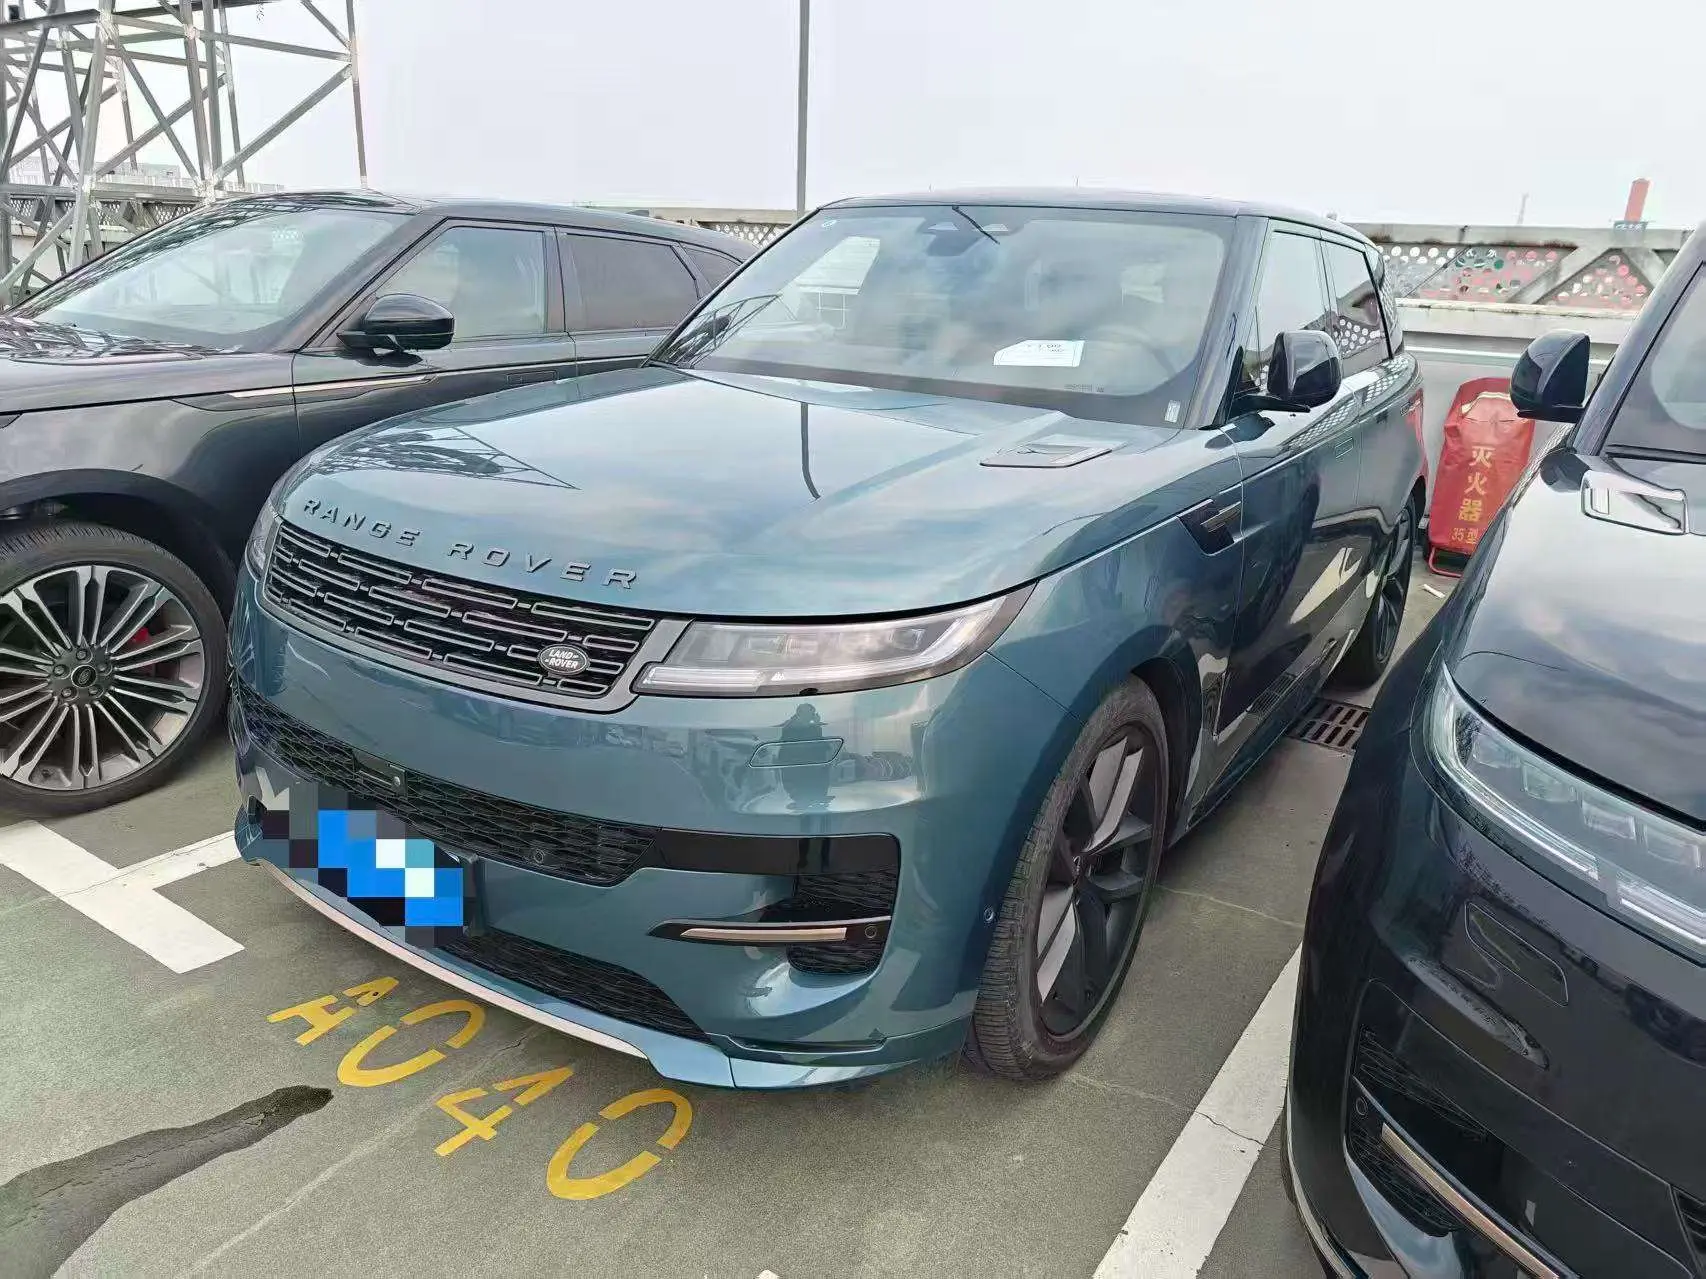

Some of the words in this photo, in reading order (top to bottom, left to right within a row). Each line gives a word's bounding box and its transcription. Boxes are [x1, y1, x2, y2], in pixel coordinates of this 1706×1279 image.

[1458, 446, 1496, 519] 灭火器
[303, 498, 422, 546] RANGE
[447, 542, 638, 589] ROVER
[549, 650, 574, 660] LAND
[549, 658, 578, 669] ROVER
[266, 976, 694, 1200] A040
